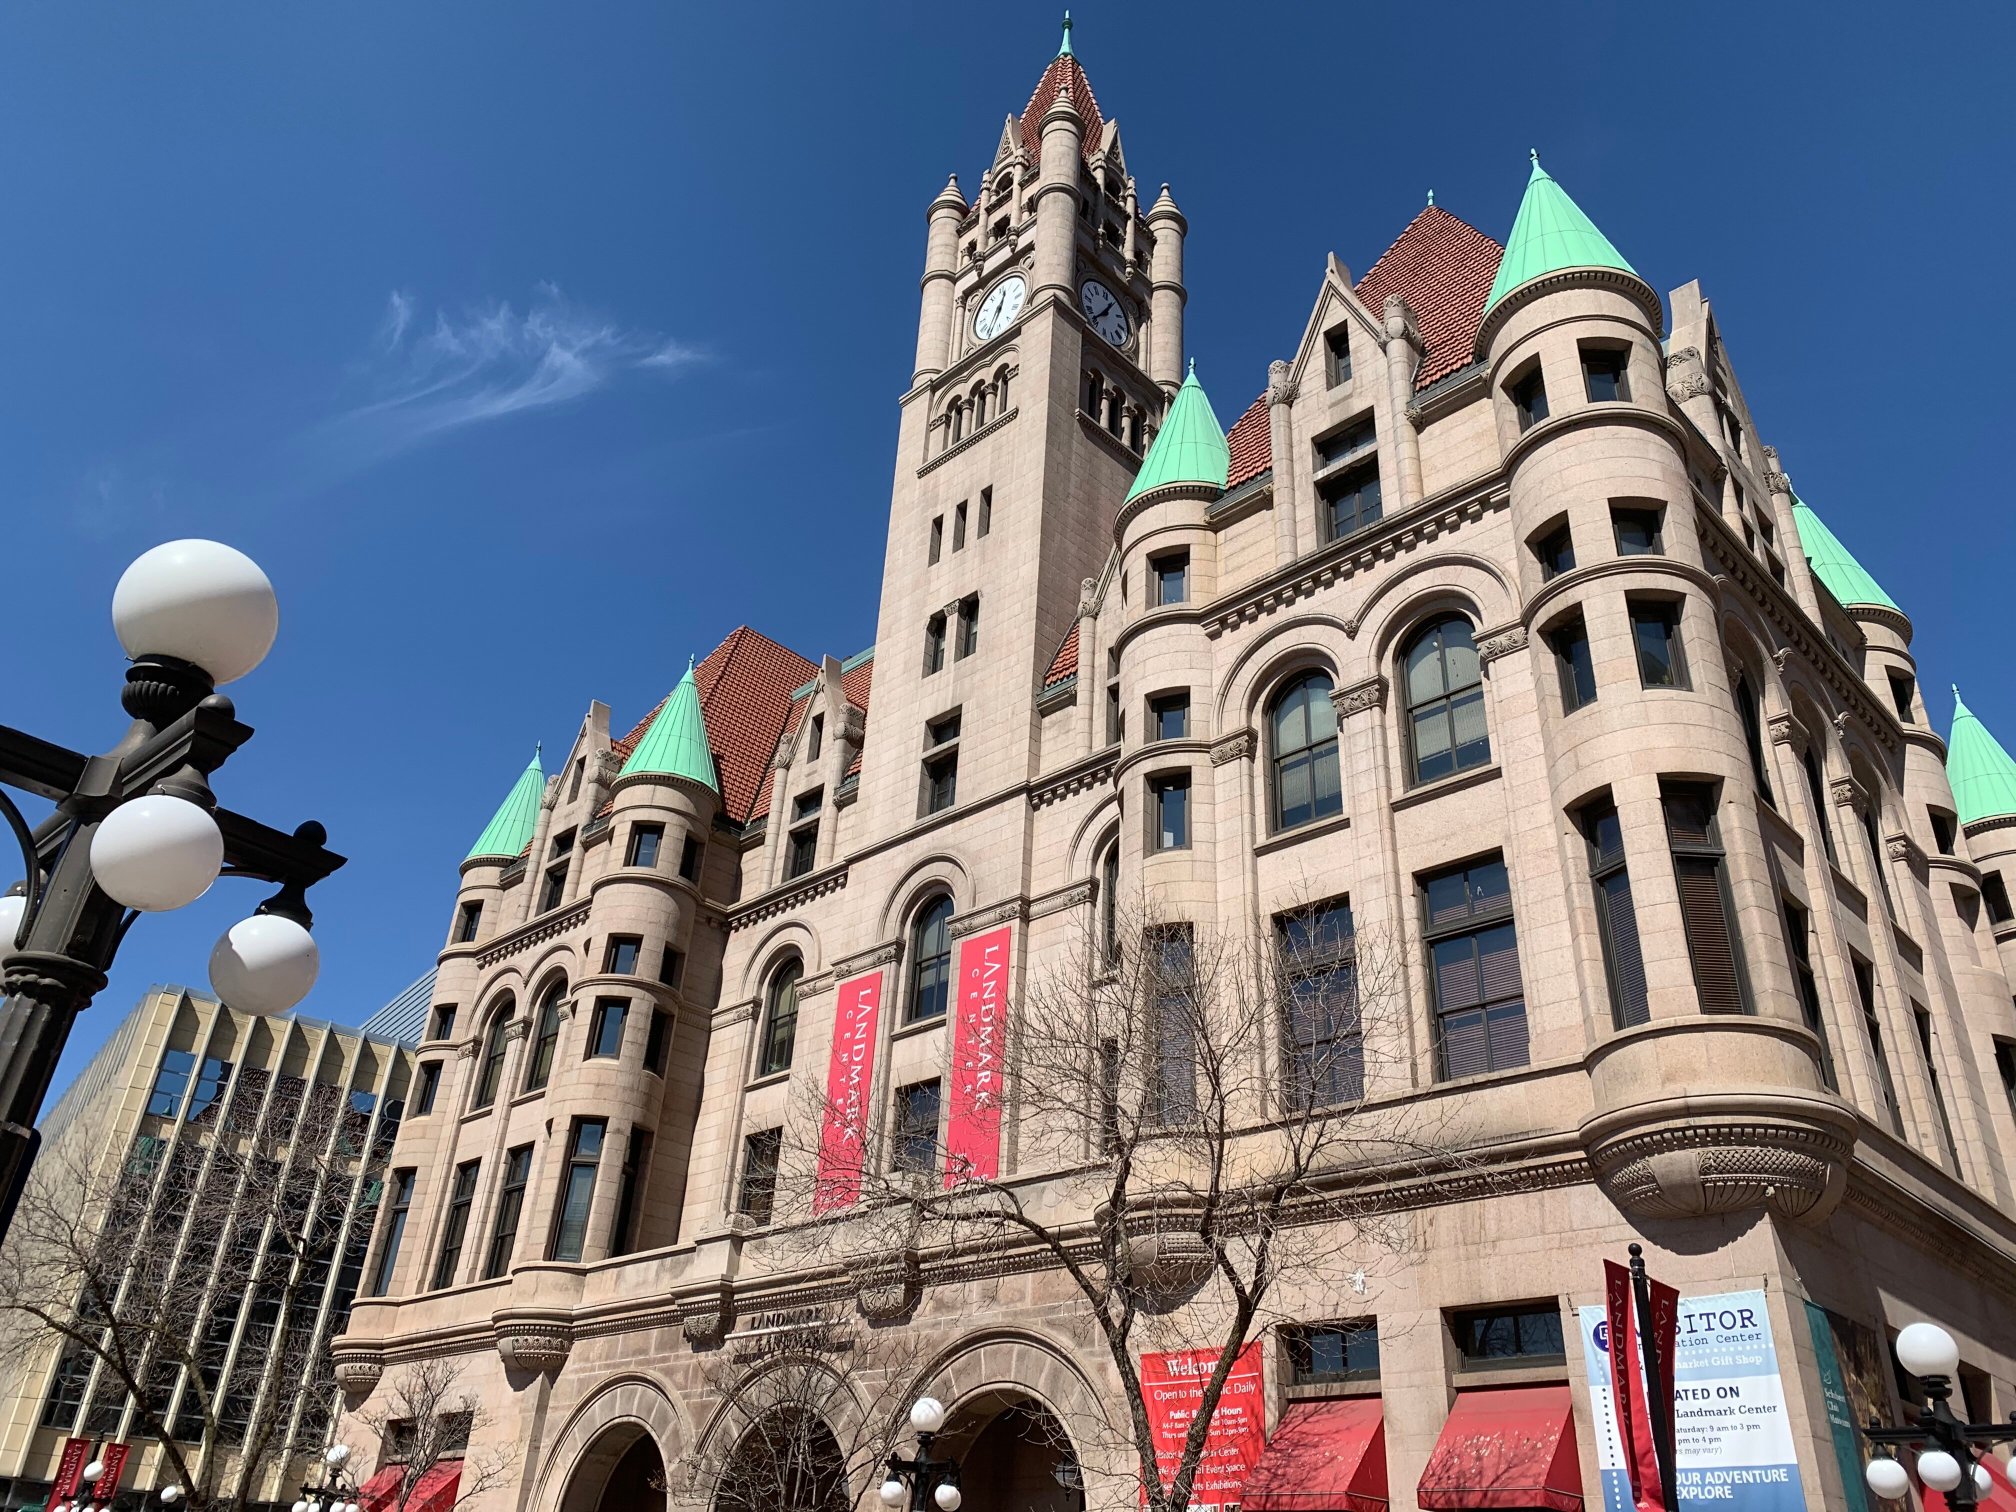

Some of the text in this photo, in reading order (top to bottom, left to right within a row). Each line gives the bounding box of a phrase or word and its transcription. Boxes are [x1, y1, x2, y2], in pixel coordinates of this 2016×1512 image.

[963, 968, 980, 1094] CENTER
[974, 944, 1002, 1111] LANDMARK
[834, 1010, 854, 1128] CENTER
[842, 988, 873, 1144] LANDMARK
[1716, 1332, 1762, 1344] Center
[1167, 1357, 1233, 1377] Welcom
[1711, 1353, 1733, 1367] Gift
[1735, 1353, 1762, 1368] Shop
[1154, 1389, 1178, 1403] Open
[1179, 1389, 1187, 1399] to
[1189, 1386, 1202, 1398] the
[1234, 1381, 1256, 1394] Daily
[1716, 1386, 1740, 1399] ON
[1169, 1409, 1190, 1420] Public
[1221, 1406, 1242, 1416] Hours
[1676, 1404, 1778, 1419] Landmark Center
[1210, 1419, 1220, 1427] Sat
[1747, 1423, 1761, 1432] pm
[1677, 1438, 1690, 1446] pm
[1701, 1436, 1707, 1444] 4
[1710, 1436, 1722, 1445] pm
[1685, 1447, 1700, 1456] may
[1702, 1446, 1723, 1456] vary)
[1225, 1463, 1246, 1476] Space
[1705, 1468, 1789, 1484] ADVENTURE
[1206, 1480, 1242, 1491] Exhibitions
[1676, 1485, 1733, 1500] EXPLORE
